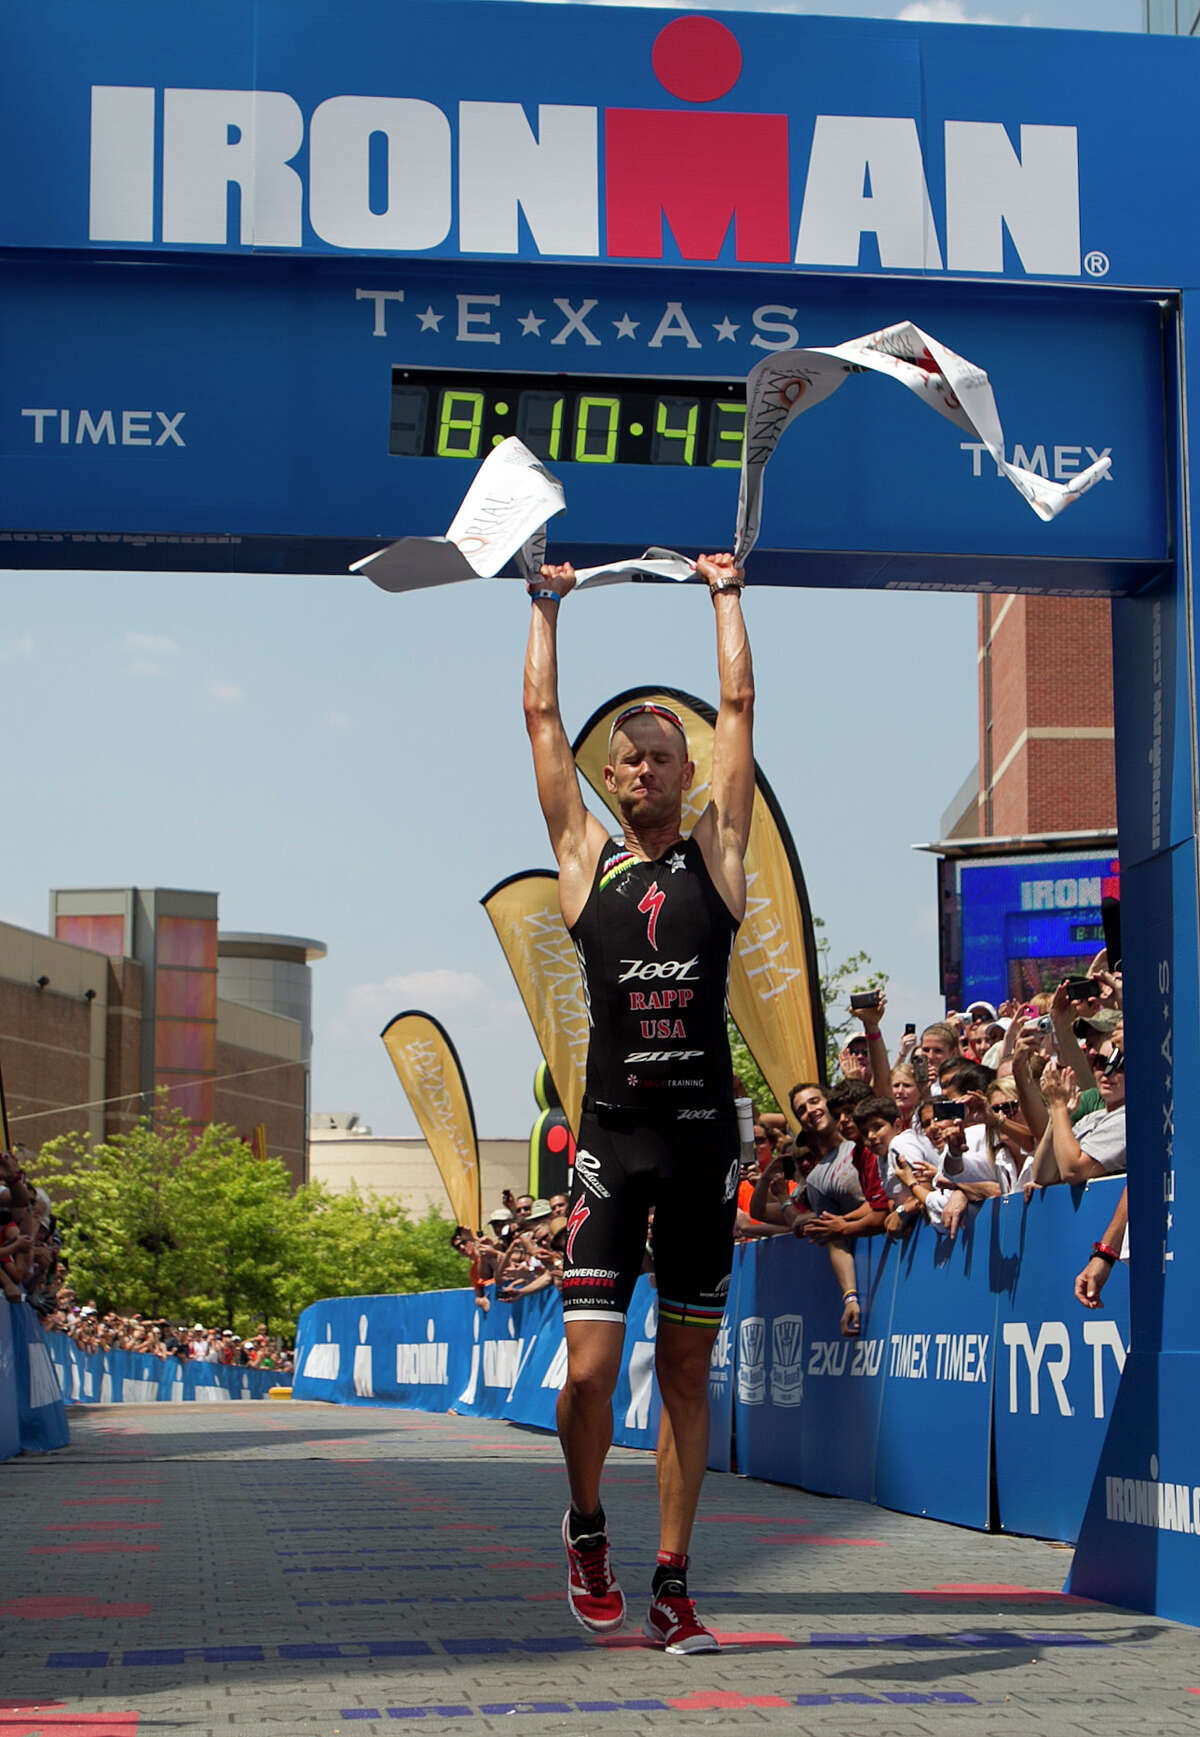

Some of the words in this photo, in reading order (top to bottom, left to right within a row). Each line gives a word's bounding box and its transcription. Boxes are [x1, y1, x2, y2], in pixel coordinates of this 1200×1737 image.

[88, 85, 1081, 275] IRONMAN
[21, 408, 186, 446] TIMEX
[629, 989, 694, 1011] RAPP
[640, 1019, 687, 1039] USA
[667, 1079, 704, 1088] TRAINING
[808, 1341, 849, 1376] 2XU
[850, 1339, 884, 1376] 2XU
[889, 1334, 930, 1379] TIMEX
[935, 1334, 990, 1383] TIMEX
[1003, 1321, 1073, 1416] TYR
